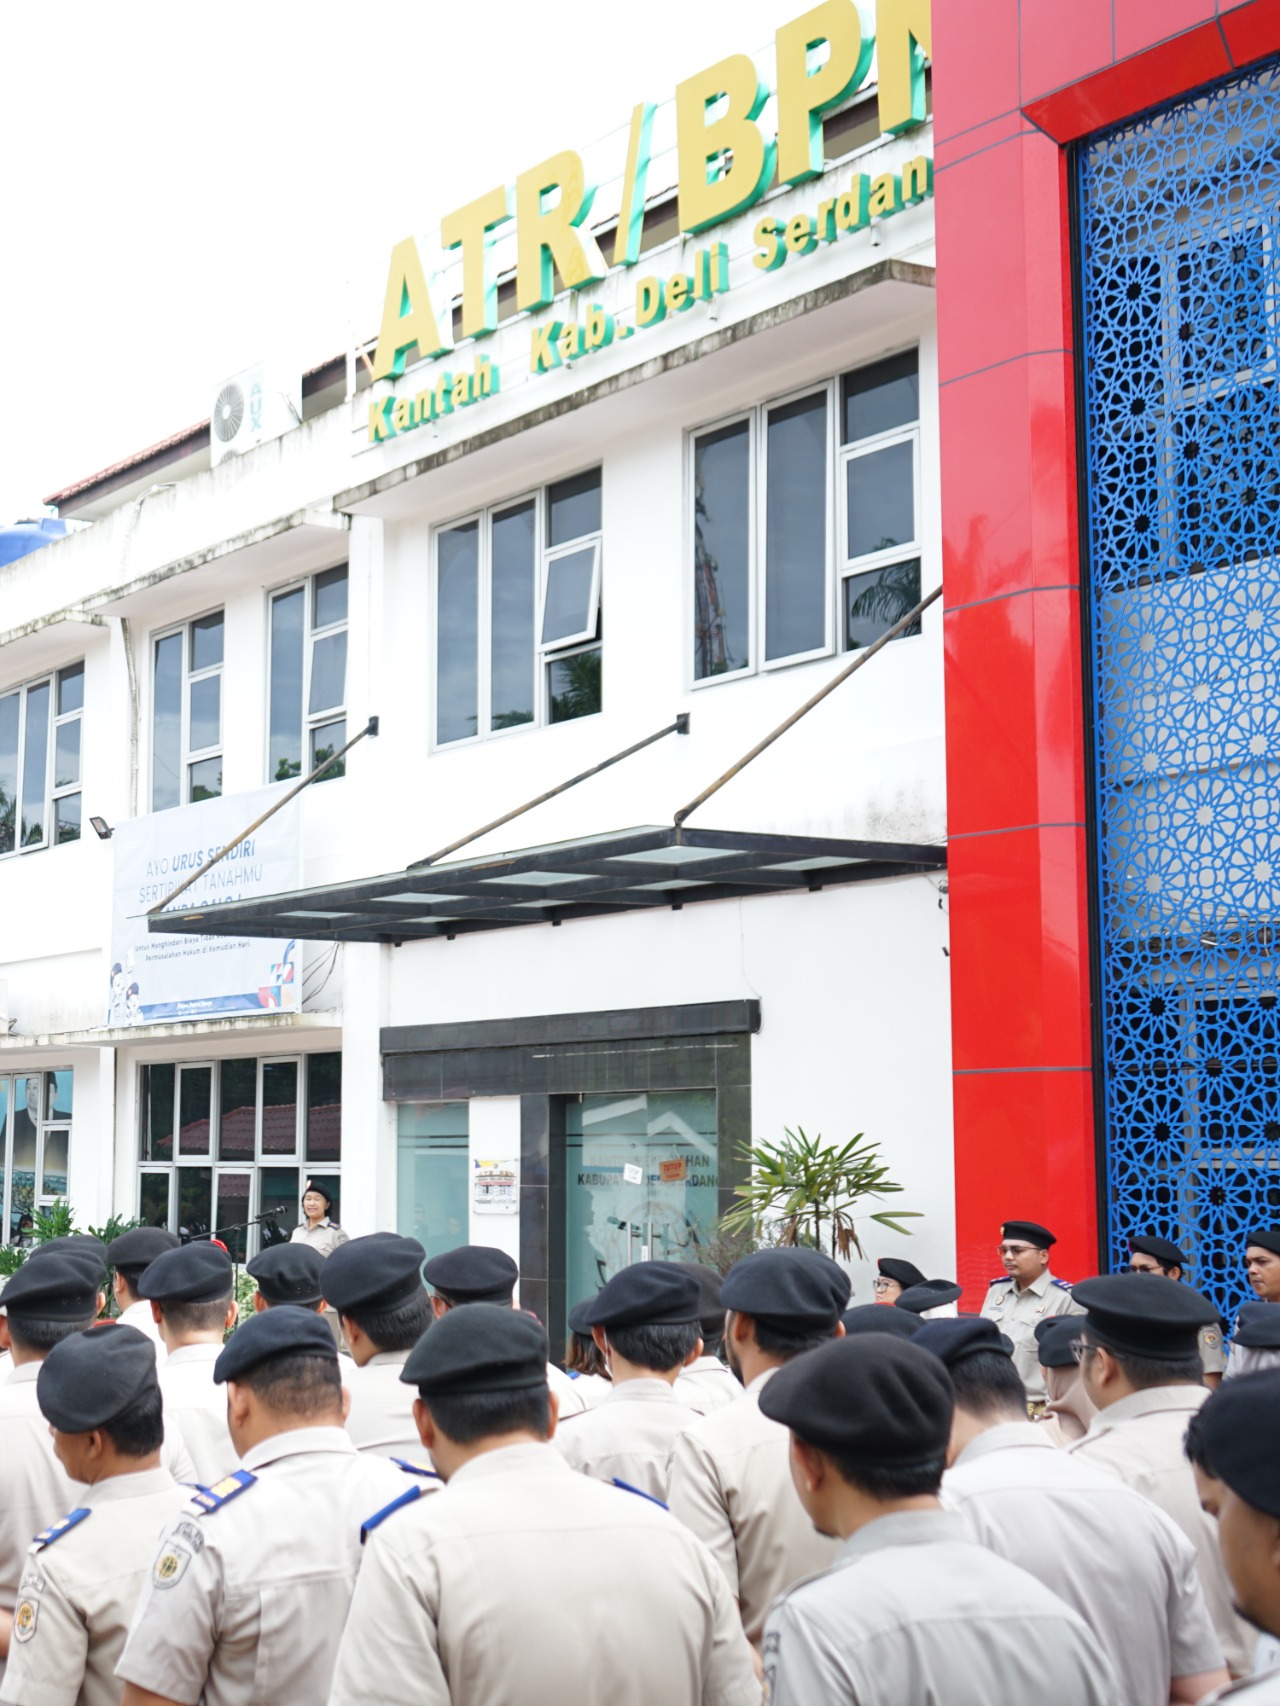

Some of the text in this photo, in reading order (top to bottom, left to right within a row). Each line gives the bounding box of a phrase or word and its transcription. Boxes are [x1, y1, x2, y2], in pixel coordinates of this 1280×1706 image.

[368, 355, 497, 442] Kantah
[752, 155, 933, 271] Serdan
[146, 858, 169, 878] AYO
[172, 850, 204, 872] URUS
[203, 864, 263, 890] TANAHMU
[663, 1162, 682, 1172] TUTUP
